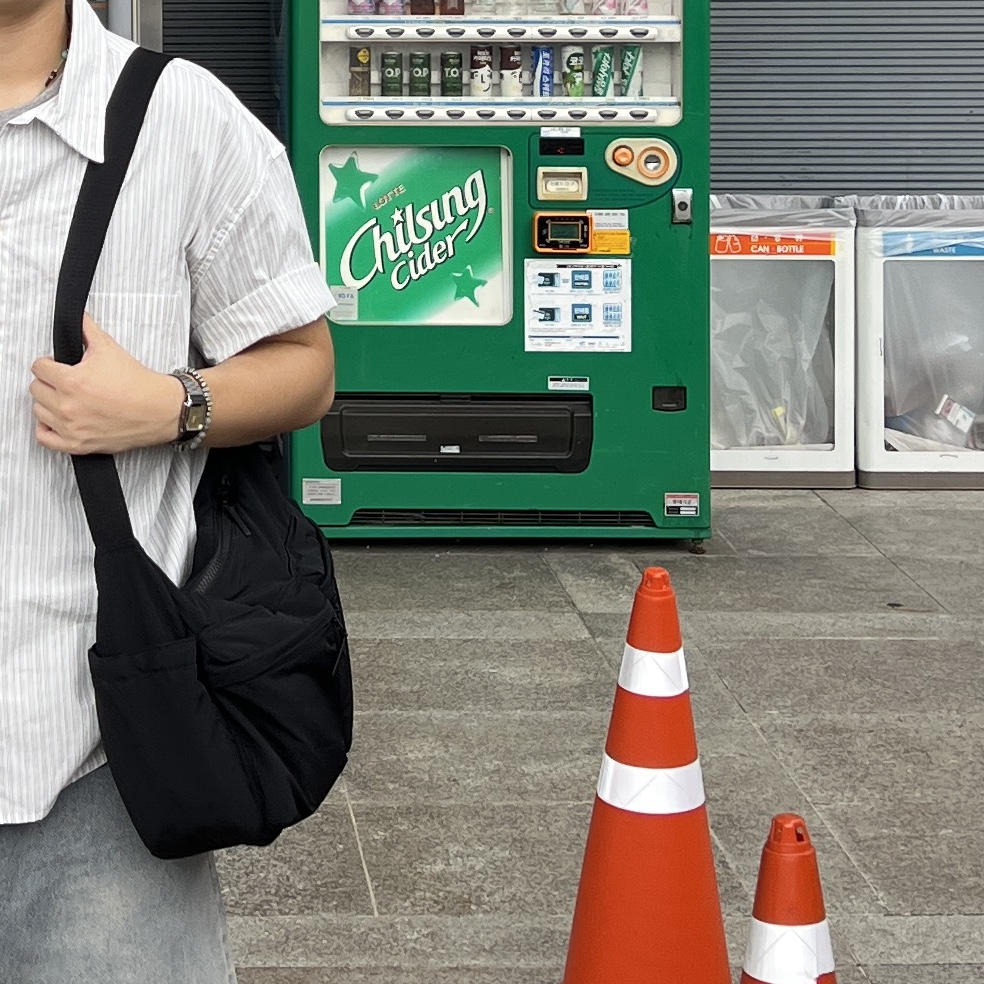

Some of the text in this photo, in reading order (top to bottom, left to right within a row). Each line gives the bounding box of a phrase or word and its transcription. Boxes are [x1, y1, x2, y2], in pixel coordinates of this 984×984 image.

[340, 169, 488, 290] Chilsung
[751, 244, 804, 253] CAN BOTTLE
